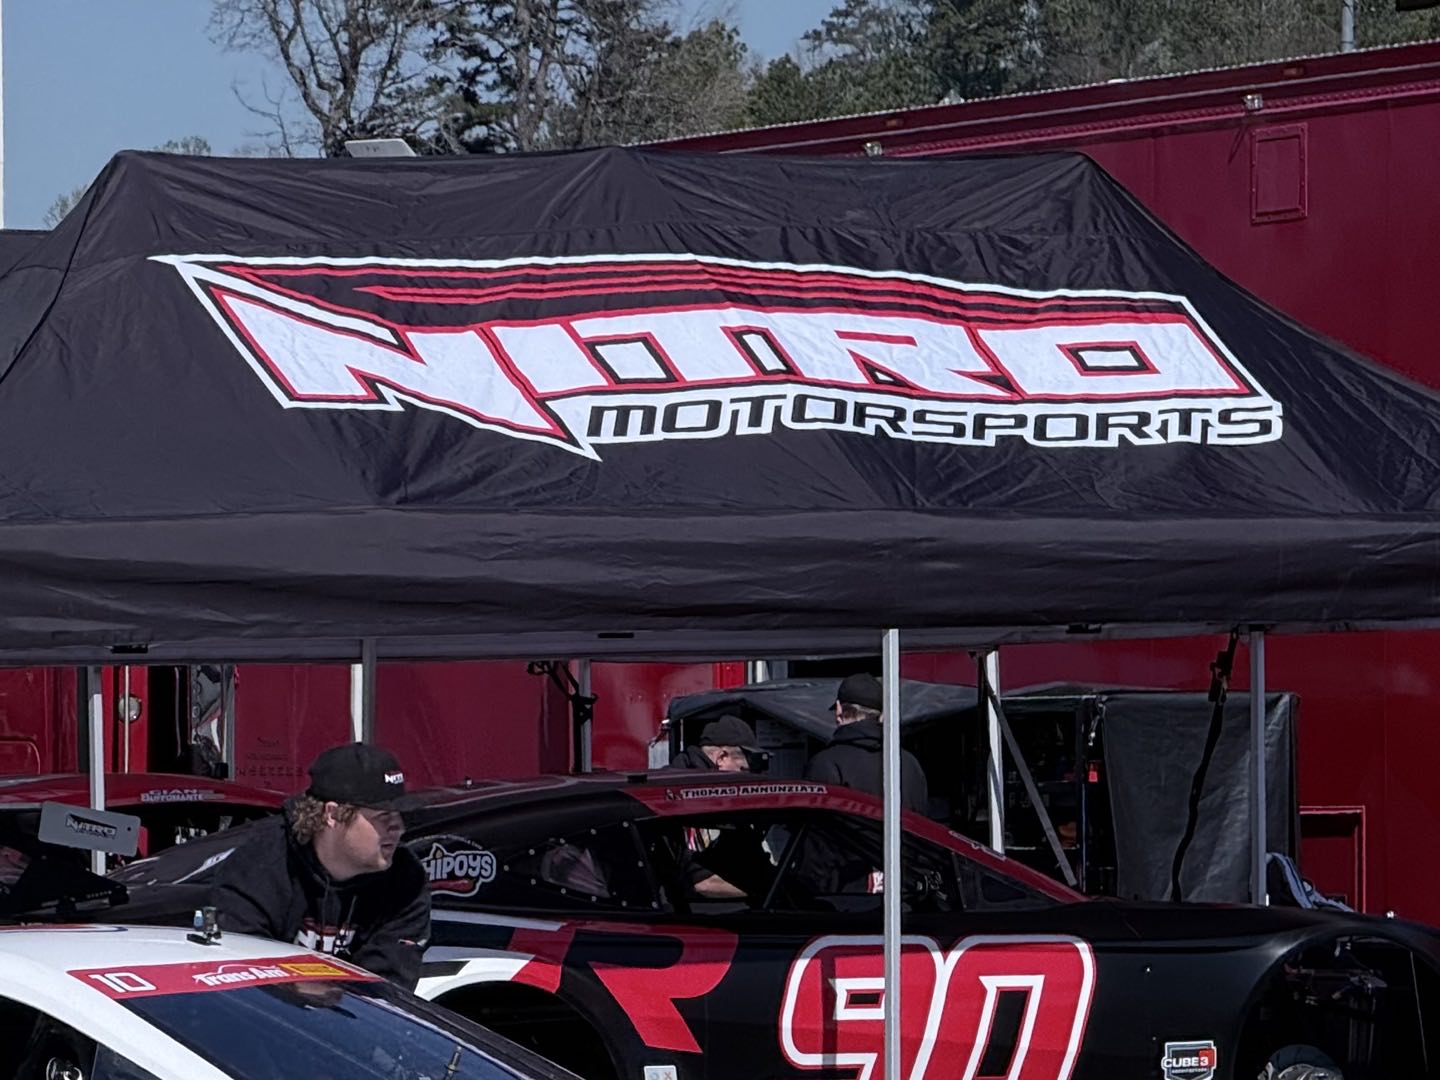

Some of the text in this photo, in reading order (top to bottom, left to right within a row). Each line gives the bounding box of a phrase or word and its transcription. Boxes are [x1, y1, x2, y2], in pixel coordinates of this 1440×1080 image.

[586, 397, 1276, 444] MOTORSPORTS
[682, 785, 826, 799] THOMAS ANNUNZIATA
[421, 854, 492, 881] HIPOYS
[88, 972, 157, 993] 10
[194, 971, 256, 986] Trans
